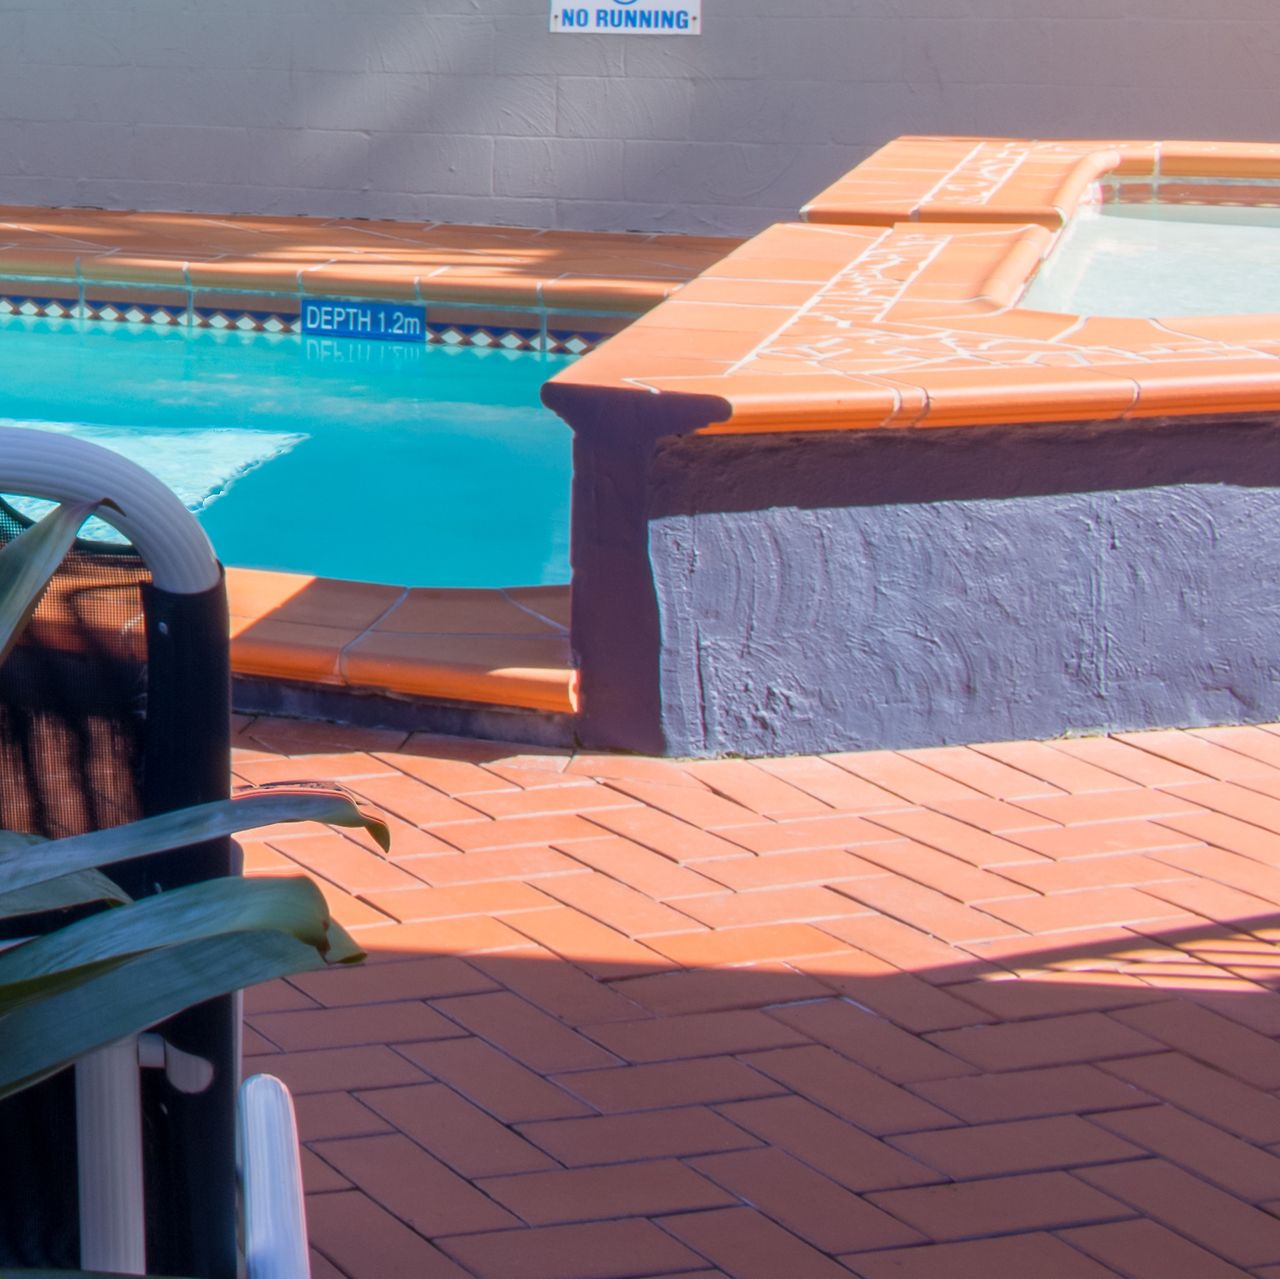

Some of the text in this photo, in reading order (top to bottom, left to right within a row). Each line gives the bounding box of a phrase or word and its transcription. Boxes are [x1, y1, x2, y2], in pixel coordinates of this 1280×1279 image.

[561, 8, 689, 30] NO RUNNING
[306, 305, 421, 335] DEPTH 1.2m
